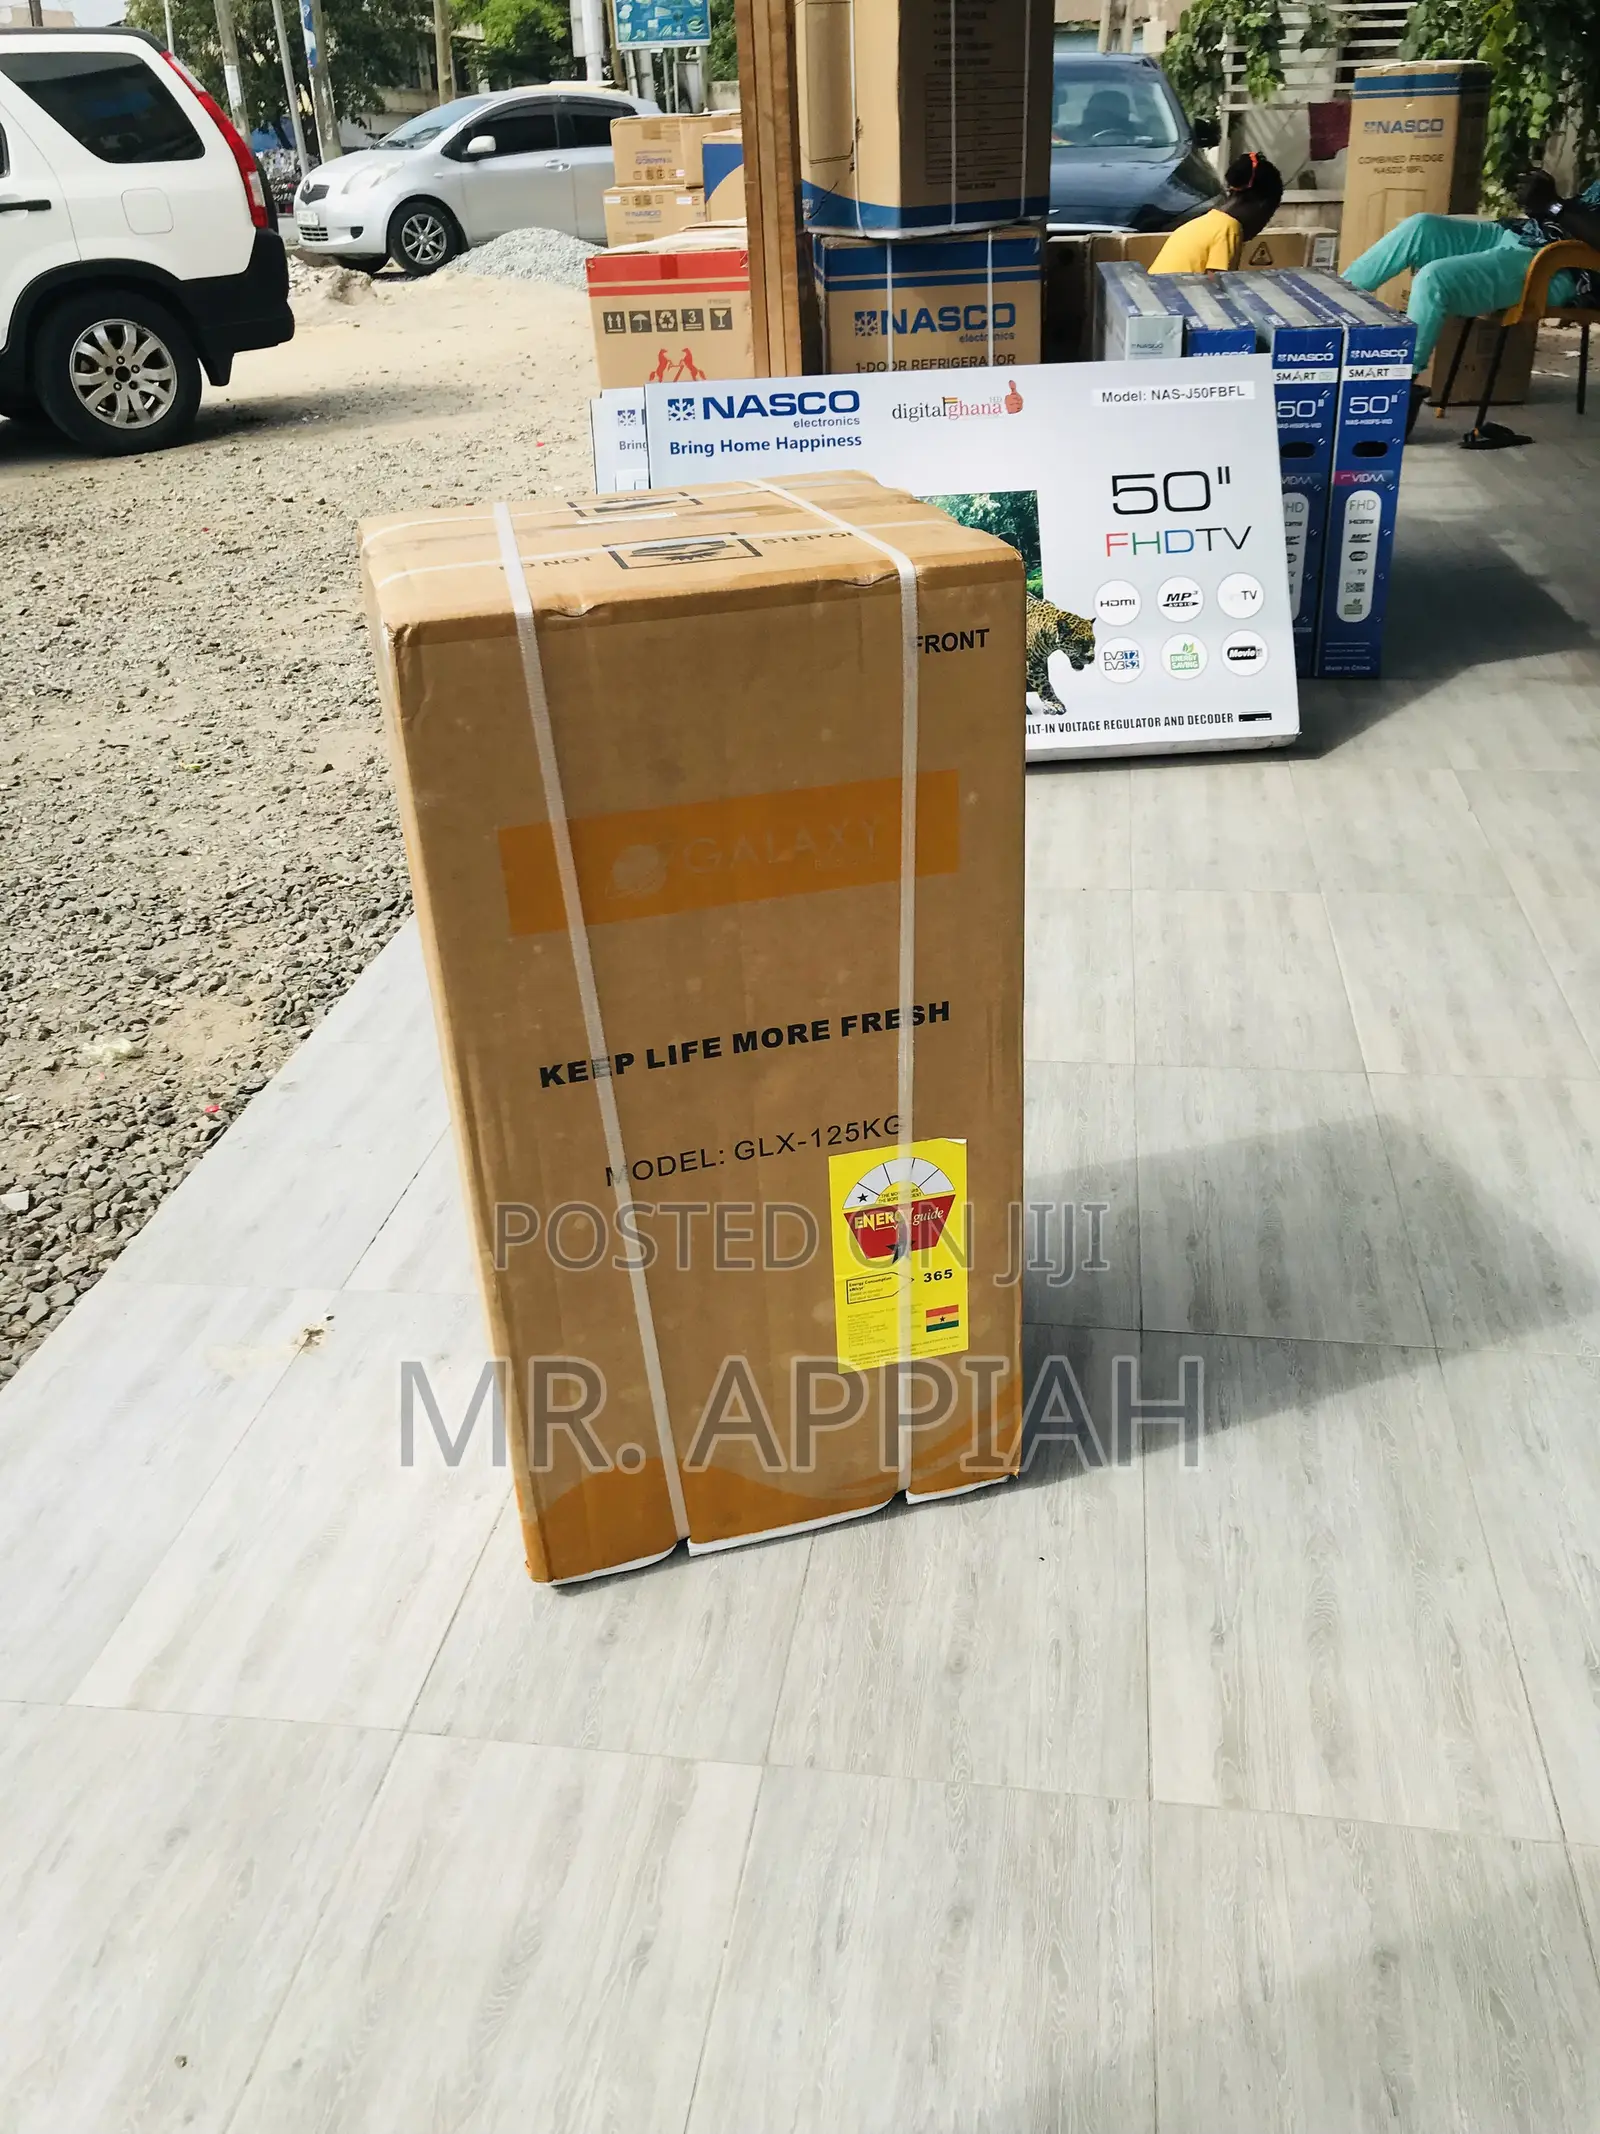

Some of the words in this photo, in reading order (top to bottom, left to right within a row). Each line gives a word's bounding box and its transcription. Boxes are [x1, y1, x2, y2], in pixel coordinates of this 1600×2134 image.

[1377, 118, 1444, 133] NASCO
[881, 302, 1016, 335] NASCO
[959, 331, 1015, 343] electrnics
[1286, 352, 1334, 363] NASCO
[1360, 349, 1408, 359] NASCO
[1276, 370, 1317, 382] SMART
[1348, 367, 1390, 378] SMART
[1101, 389, 1147, 403] Model:
[1150, 386, 1246, 401] NAS-J50FBFL
[702, 389, 861, 420] NASCO
[793, 417, 861, 428] electronics
[619, 440, 648, 452] Bring
[669, 441, 715, 457] Bring
[720, 439, 771, 453] Home
[776, 434, 863, 454] Happiness
[1284, 501, 1305, 514] HD
[1349, 499, 1377, 511] FHD
[761, 534, 822, 545] STEP
[1105, 525, 1252, 557] FHDTV
[543, 556, 592, 567] NOT
[1241, 590, 1258, 601] TV
[1100, 598, 1136, 608] HDMI
[1025, 719, 1056, 735] ILT-IN
[1058, 718, 1101, 733] VOLTAGE
[1103, 716, 1161, 731] REGULATOR
[1164, 714, 1185, 726] AND
[1187, 712, 1234, 725] DECODER
[682, 816, 880, 874] GALAXY
[539, 1052, 635, 1088] KEEP
[646, 1036, 723, 1070] LIFE
[732, 1019, 831, 1054] MORE
[840, 1000, 951, 1037] FRESH
[734, 1114, 905, 1161] GLX-125KG
[912, 1206, 945, 1226] guide
[923, 1268, 953, 1283] 365
